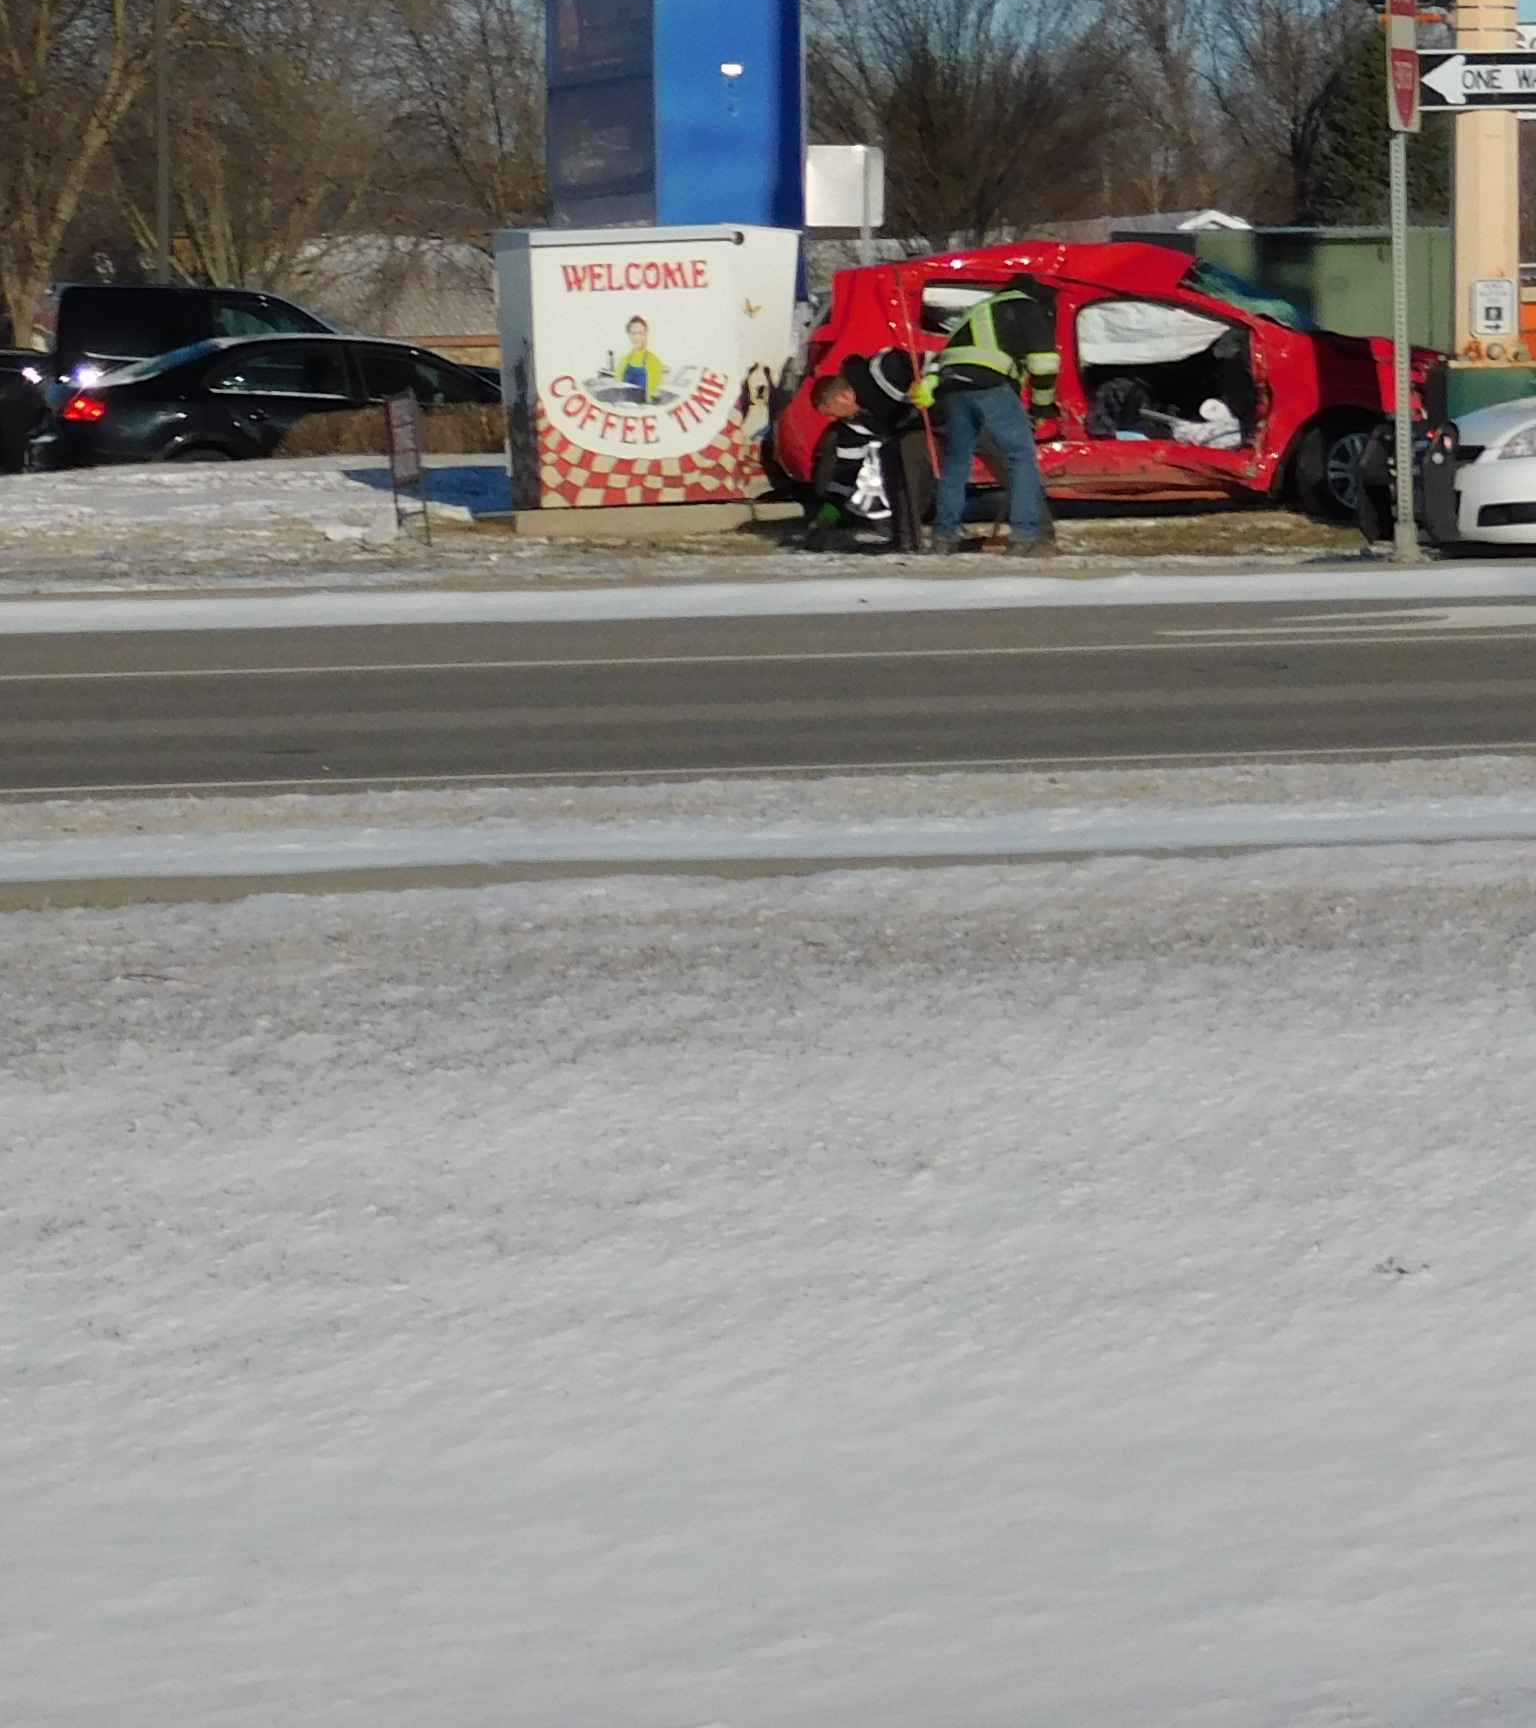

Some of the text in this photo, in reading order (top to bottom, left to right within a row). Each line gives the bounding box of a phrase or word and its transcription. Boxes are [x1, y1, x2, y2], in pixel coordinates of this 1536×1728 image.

[1461, 69, 1503, 90] ONE
[561, 260, 709, 293] WELCOME
[550, 366, 728, 445] COFFEE TIME
